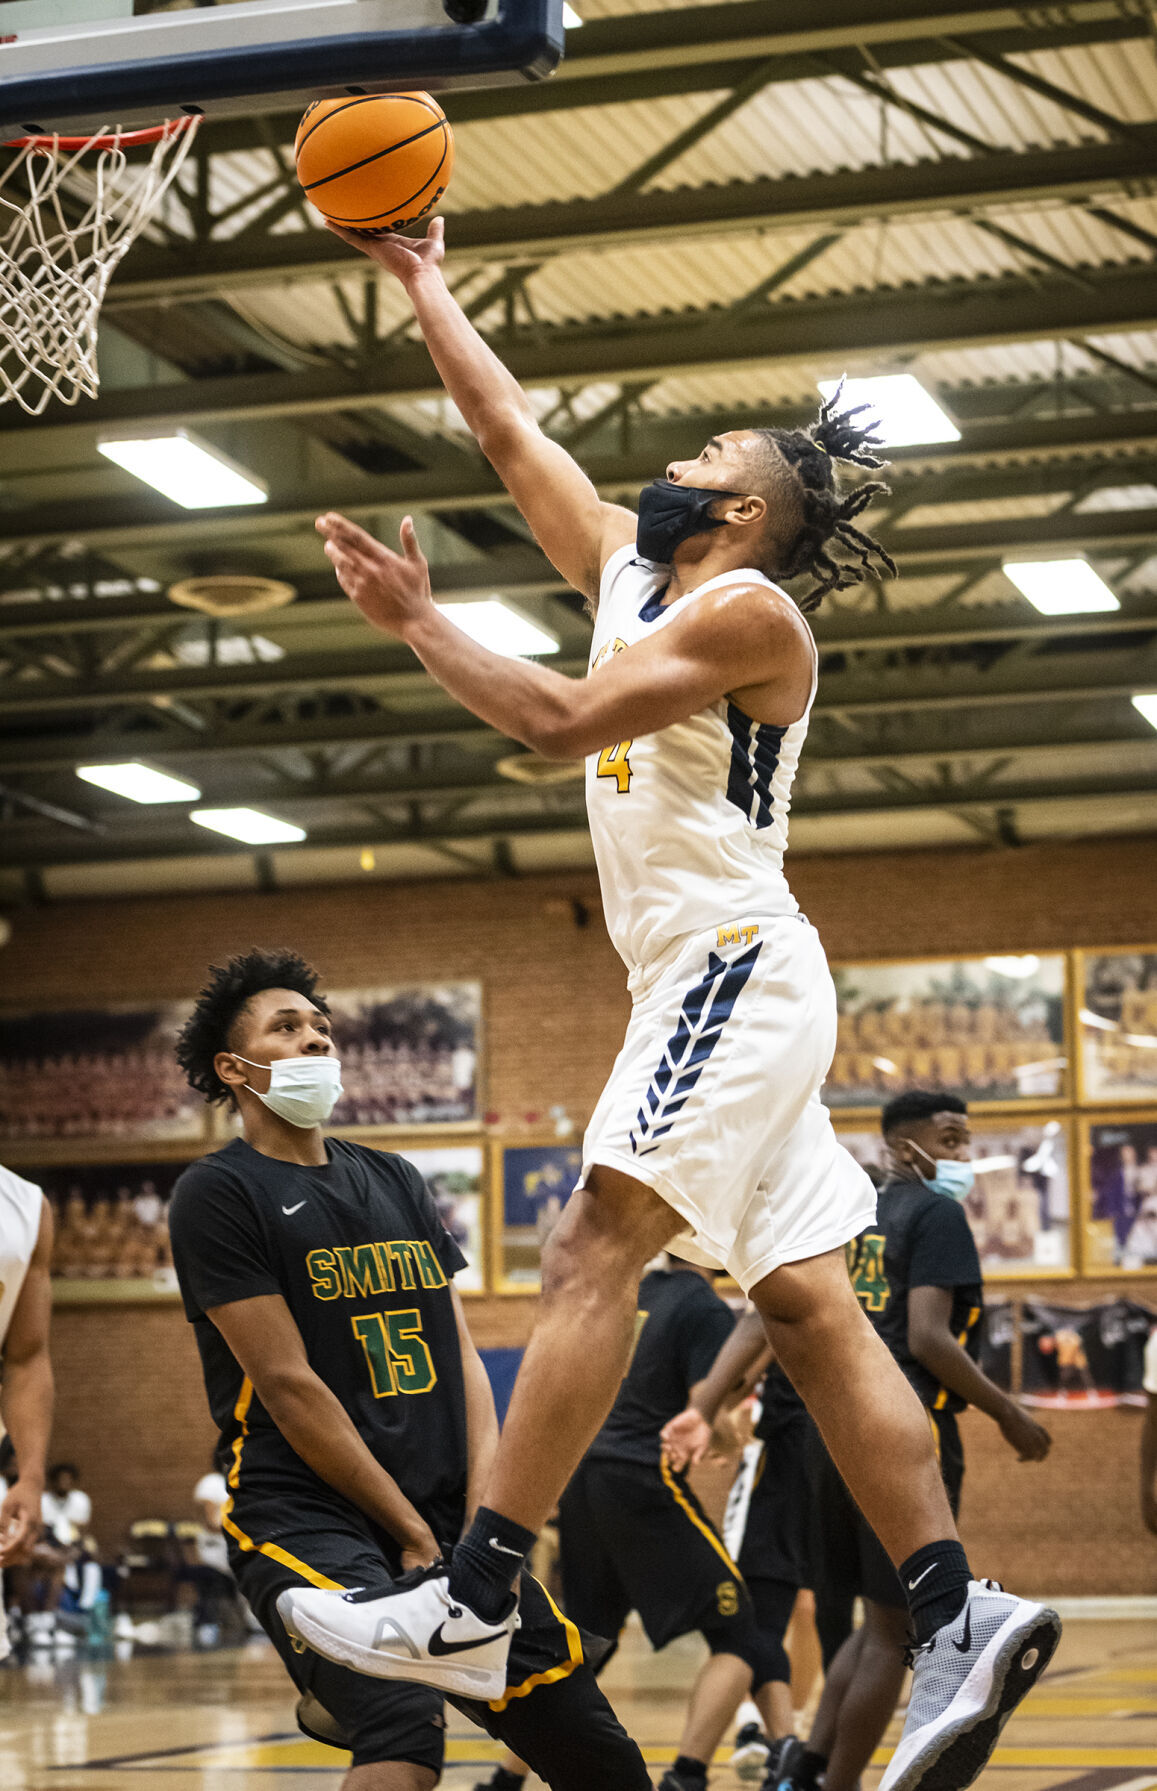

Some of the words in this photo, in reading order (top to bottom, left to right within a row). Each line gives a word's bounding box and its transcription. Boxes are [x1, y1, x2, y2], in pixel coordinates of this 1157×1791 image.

[597, 740, 633, 794] 4
[716, 922, 759, 947] MT
[305, 1240, 449, 1301] SMITH
[846, 1233, 891, 1312] 4
[351, 1308, 438, 1399] 15
